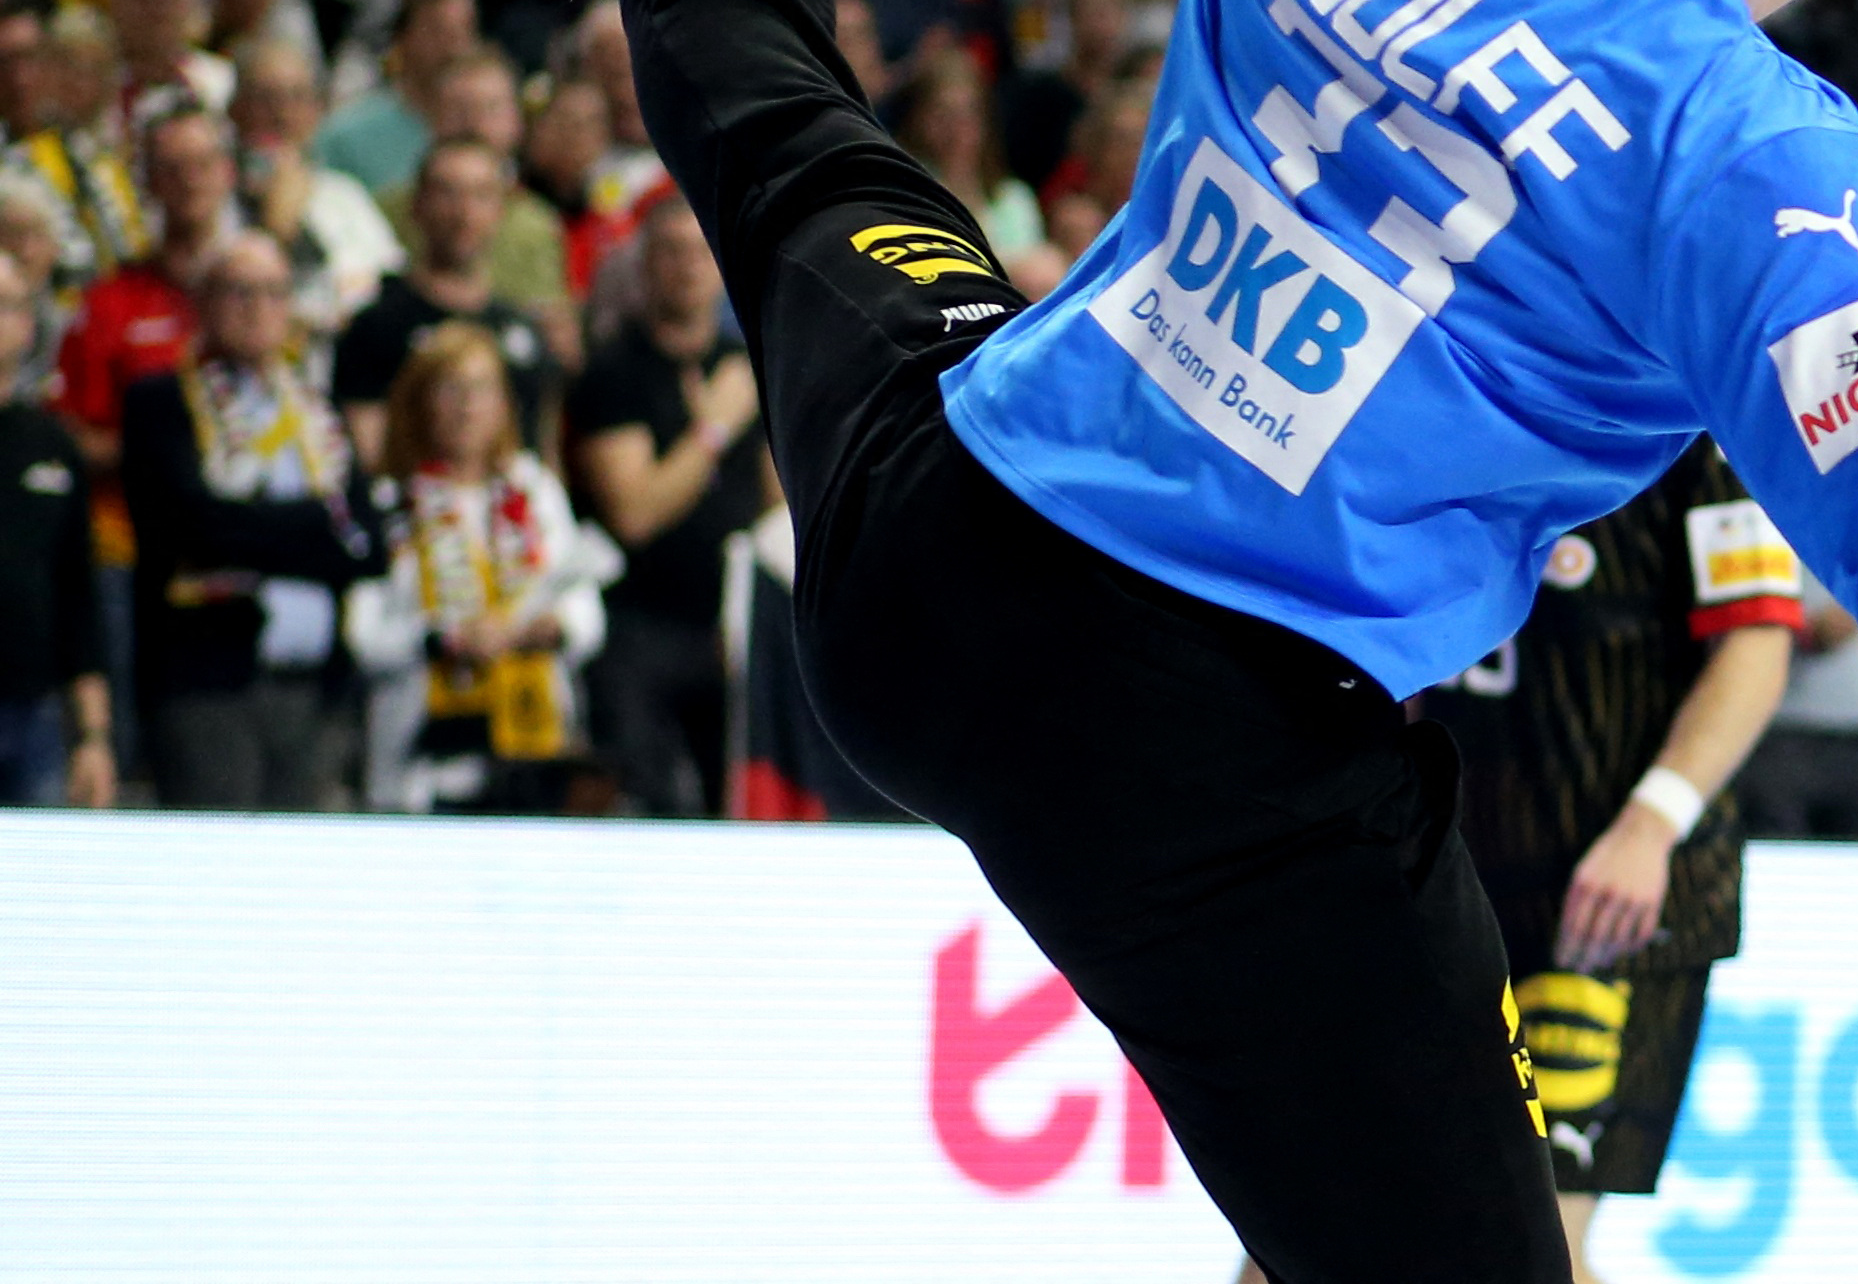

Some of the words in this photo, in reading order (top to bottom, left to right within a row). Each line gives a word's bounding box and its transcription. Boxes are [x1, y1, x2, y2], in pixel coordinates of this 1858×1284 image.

[1129, 287, 1171, 343] Das
[1167, 325, 1218, 390] kann
[1218, 371, 1297, 451] Bank
[1166, 175, 1368, 396] DKB
